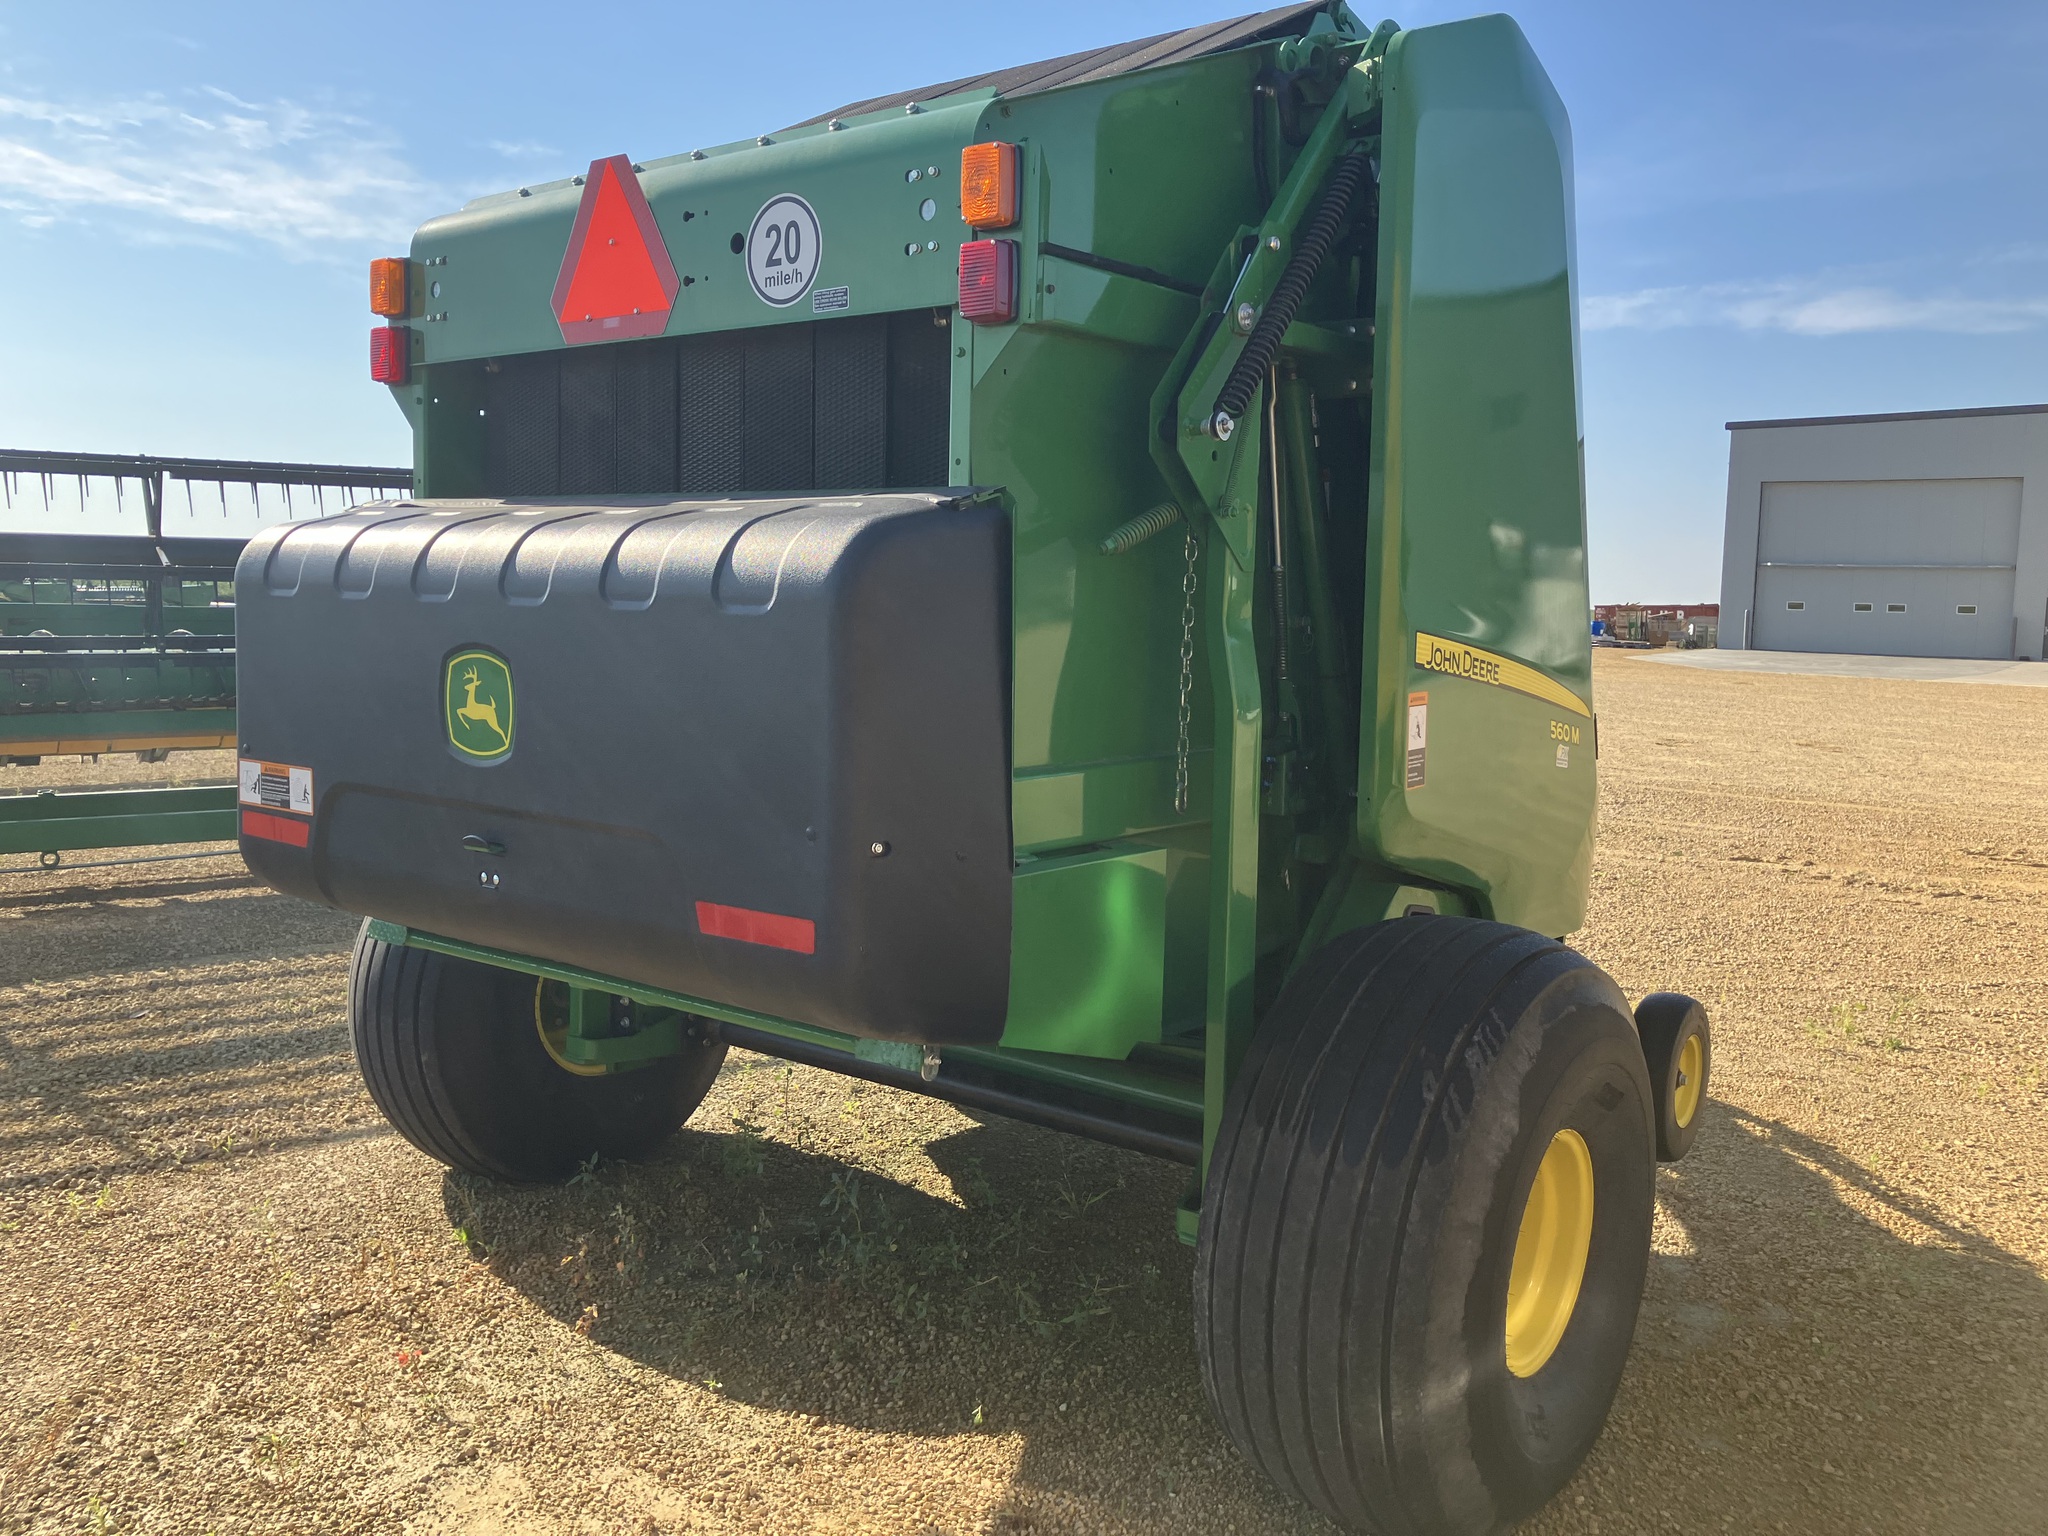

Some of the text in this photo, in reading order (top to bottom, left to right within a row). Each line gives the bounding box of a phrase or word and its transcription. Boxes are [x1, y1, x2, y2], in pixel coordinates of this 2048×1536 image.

[765, 220, 801, 268] 20
[764, 268, 802, 288] mile/h
[1426, 642, 1500, 682] JOHN DEERE
[1550, 720, 1580, 745] 560 M
